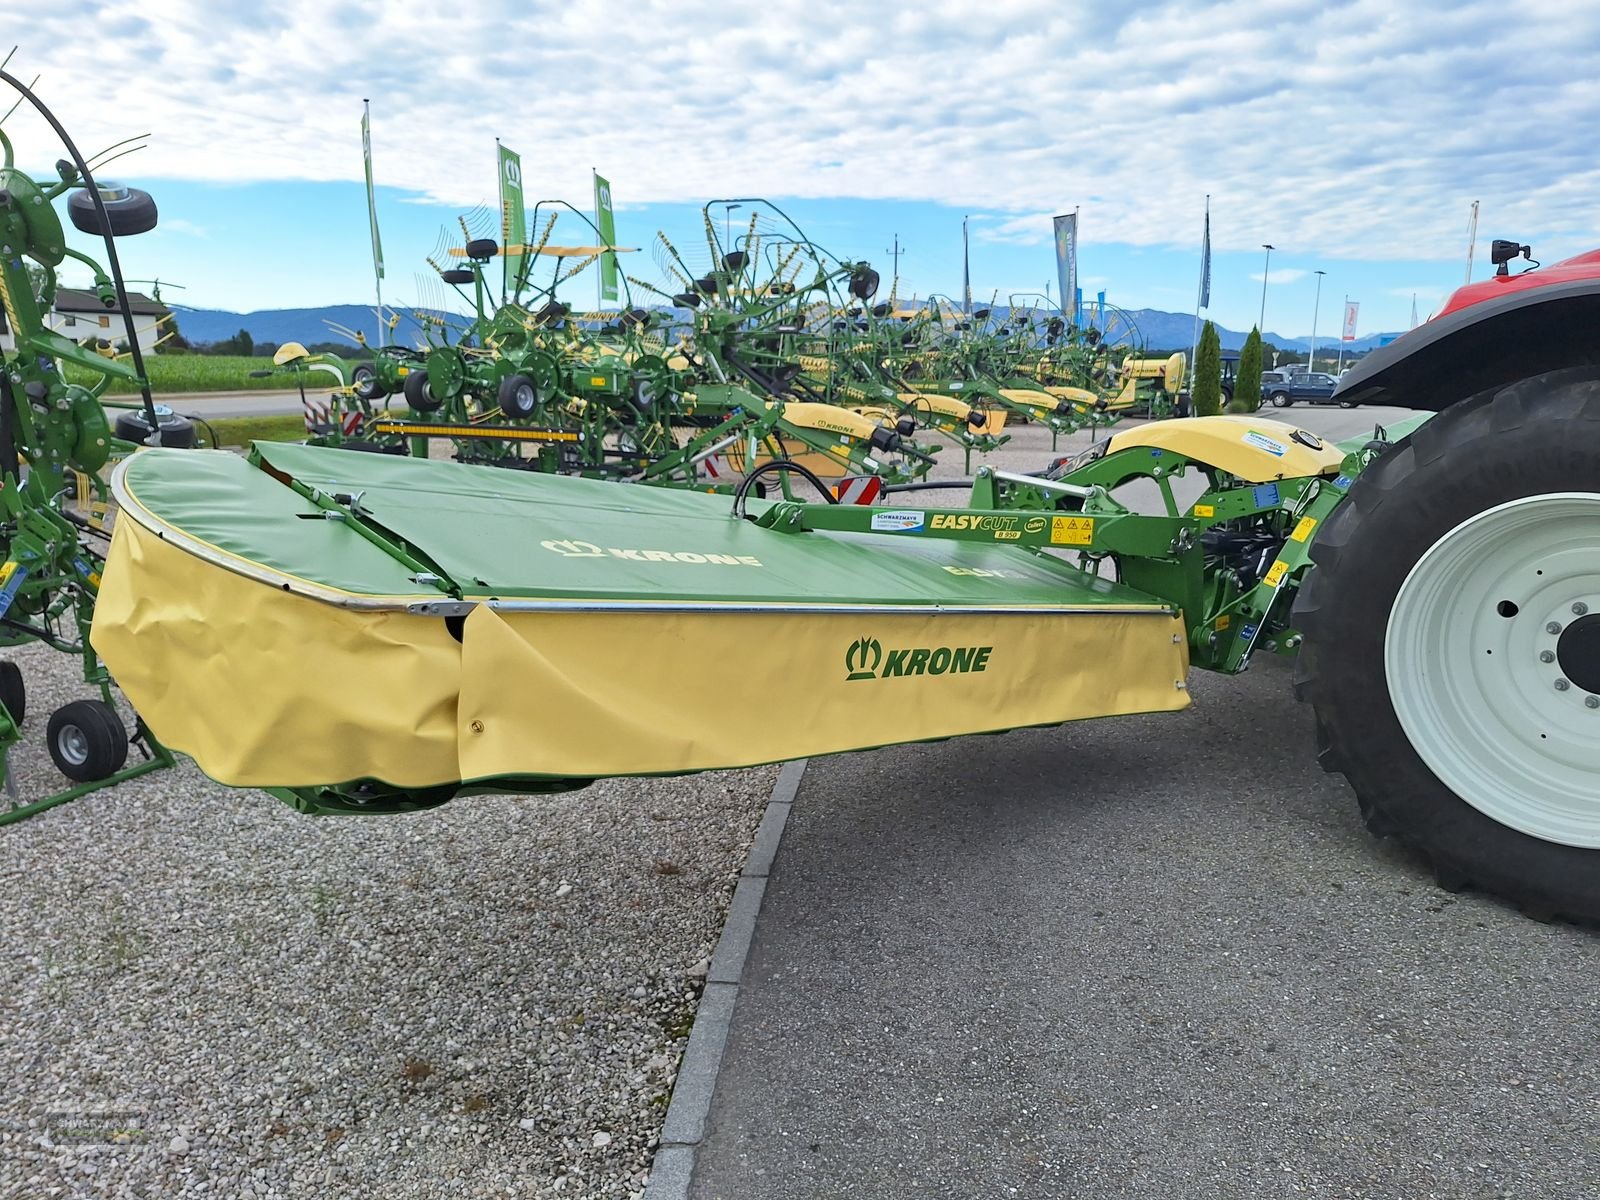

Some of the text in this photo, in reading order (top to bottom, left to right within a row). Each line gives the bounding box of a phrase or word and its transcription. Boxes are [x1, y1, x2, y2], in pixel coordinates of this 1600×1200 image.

[826, 423, 855, 433] KRONE
[931, 514, 1018, 530] EASYCUT
[1027, 521, 1044, 529] Collect
[608, 548, 764, 567] KRONE
[881, 646, 993, 678] KRONE
